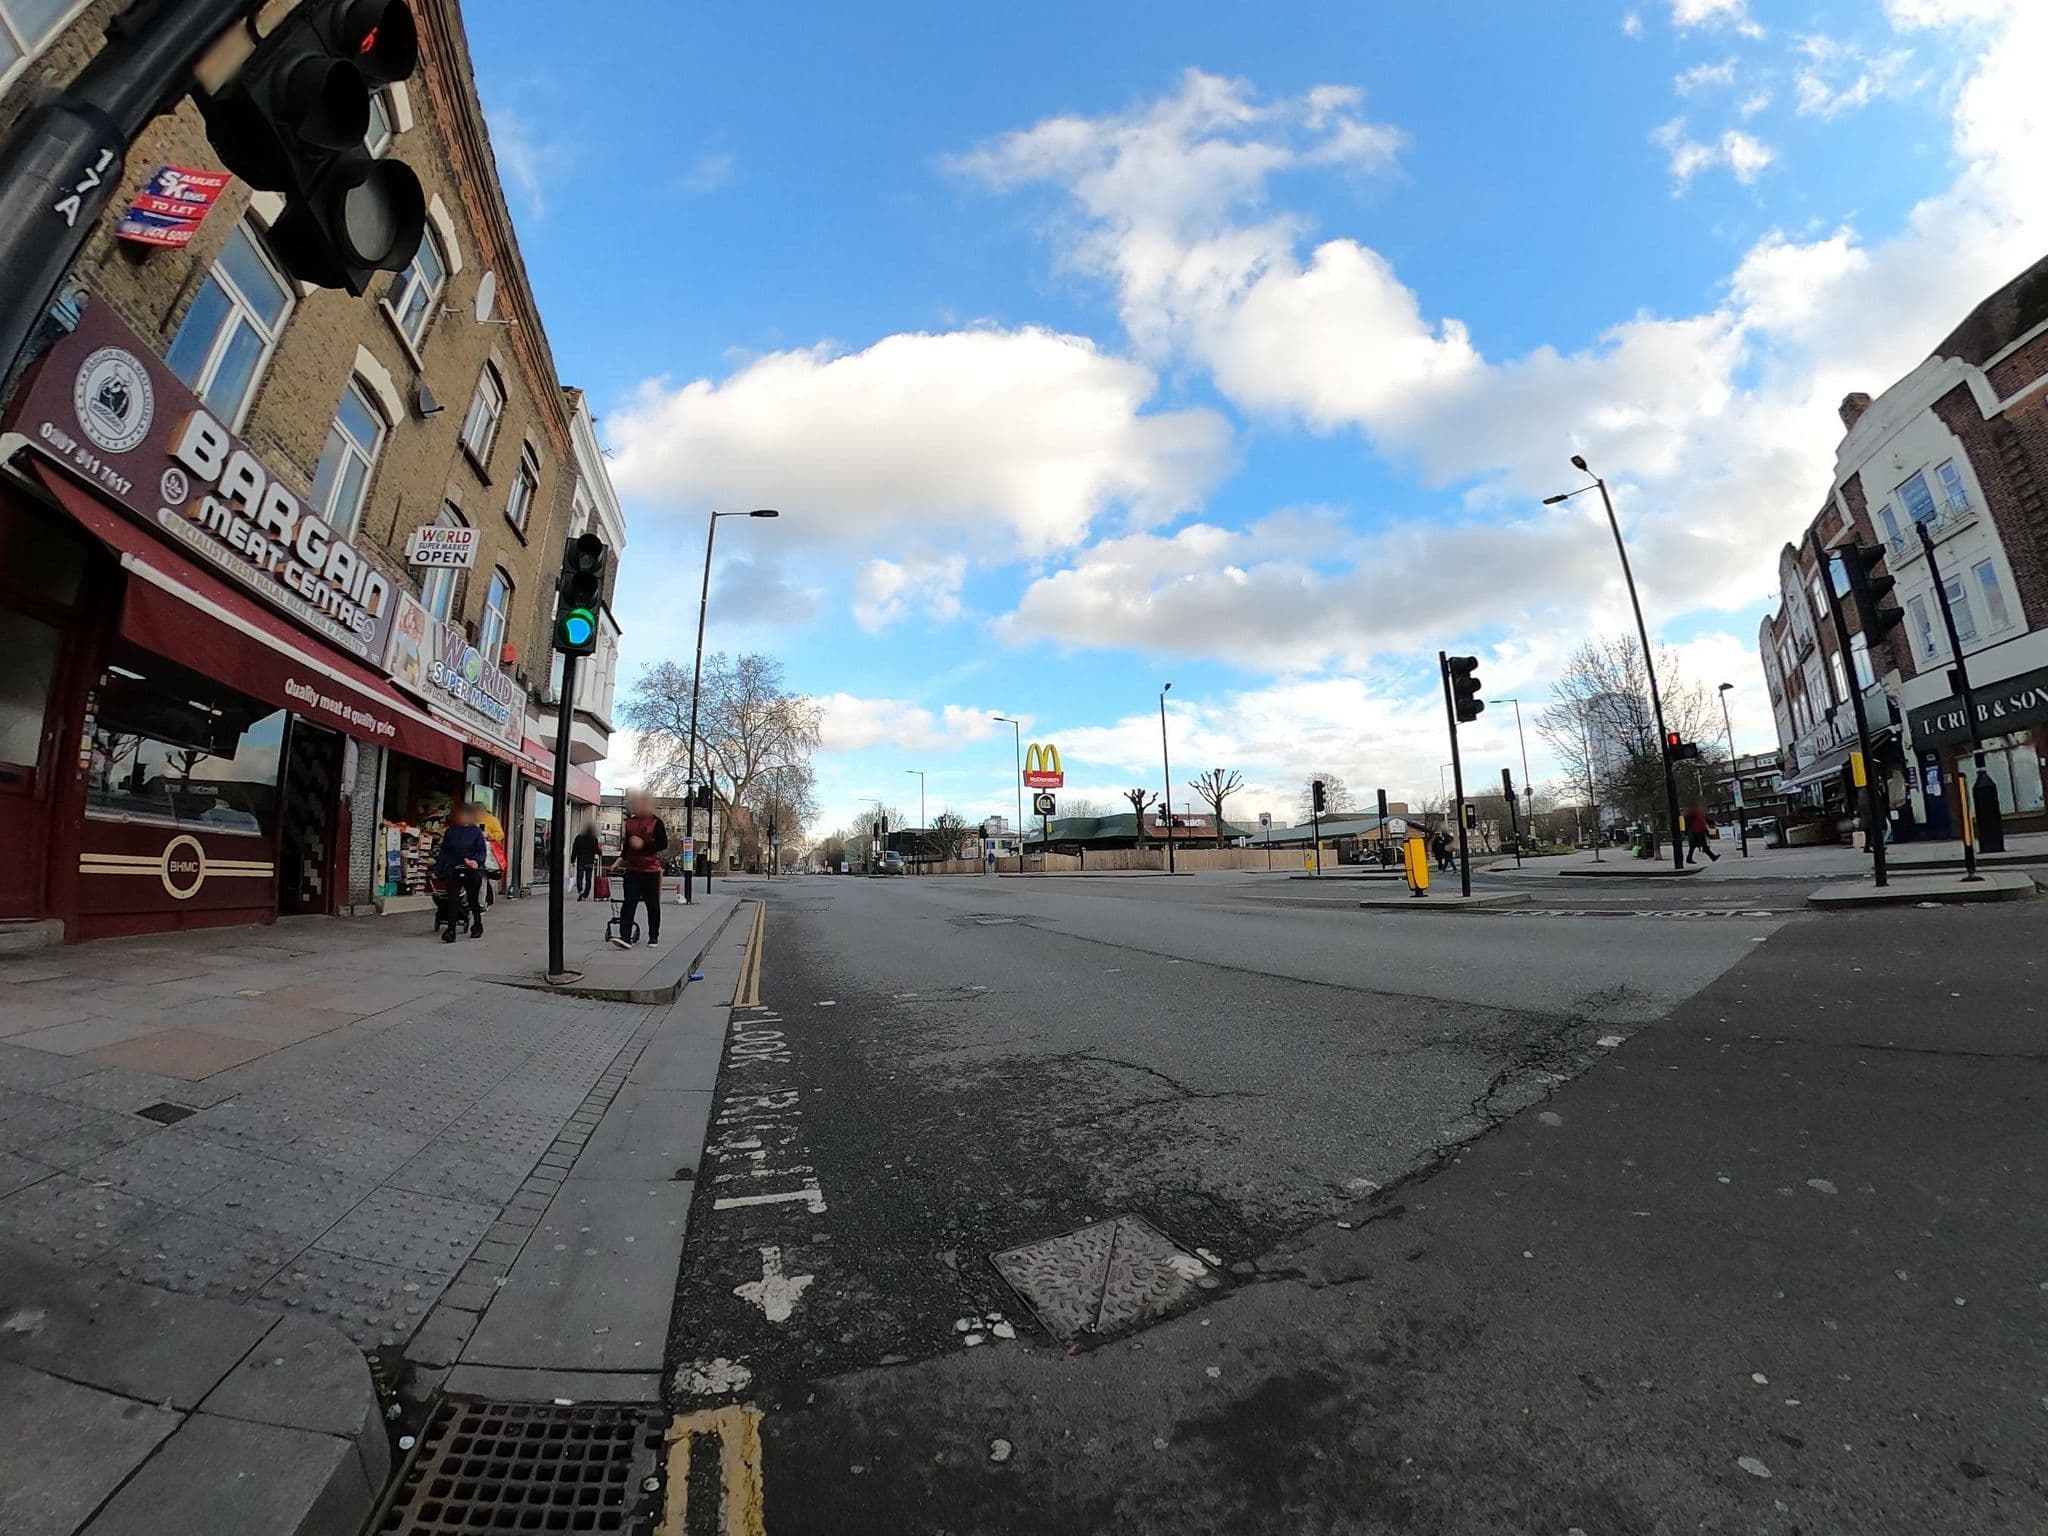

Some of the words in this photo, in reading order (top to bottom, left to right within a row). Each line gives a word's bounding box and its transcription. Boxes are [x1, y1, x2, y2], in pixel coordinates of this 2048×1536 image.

[152, 200, 169, 209] TO
[170, 204, 197, 215] LET
[176, 409, 390, 618] BARGAIN
[422, 529, 472, 544] WORLD
[198, 495, 286, 572] MEAT
[284, 561, 367, 634] CENTRE
[416, 550, 468, 564] OPEN
[441, 622, 514, 706] WORLD
[285, 678, 320, 707] Quality
[319, 695, 343, 716] meat
[342, 705, 352, 720] at
[351, 710, 377, 732] quality
[1993, 700, 2006, 717] &
[169, 859, 199, 873] BHMC
[728, 1018, 793, 1068] LOOK
